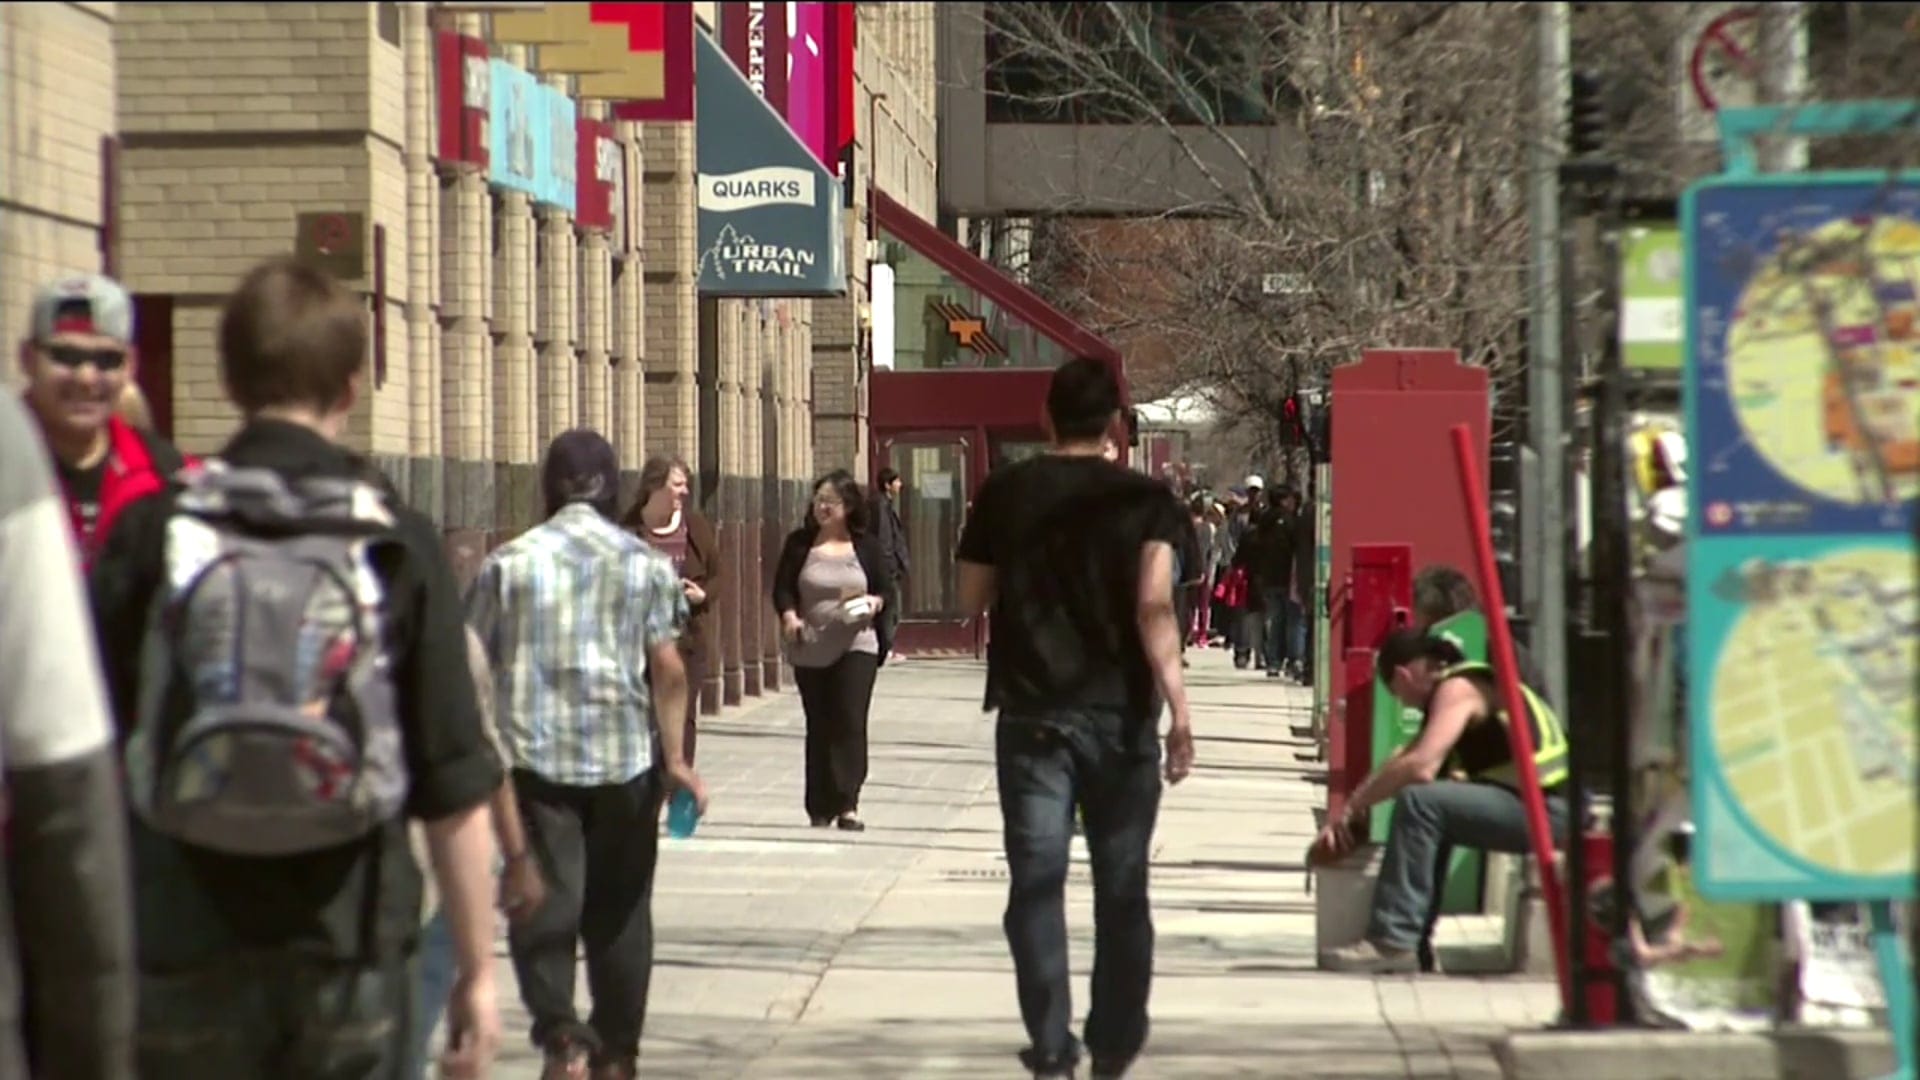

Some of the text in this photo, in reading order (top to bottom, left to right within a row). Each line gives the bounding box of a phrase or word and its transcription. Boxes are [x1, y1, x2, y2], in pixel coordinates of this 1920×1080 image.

[712, 180, 801, 198] QUARKS
[722, 244, 815, 266] URBAN
[731, 258, 807, 279] TRAIL
